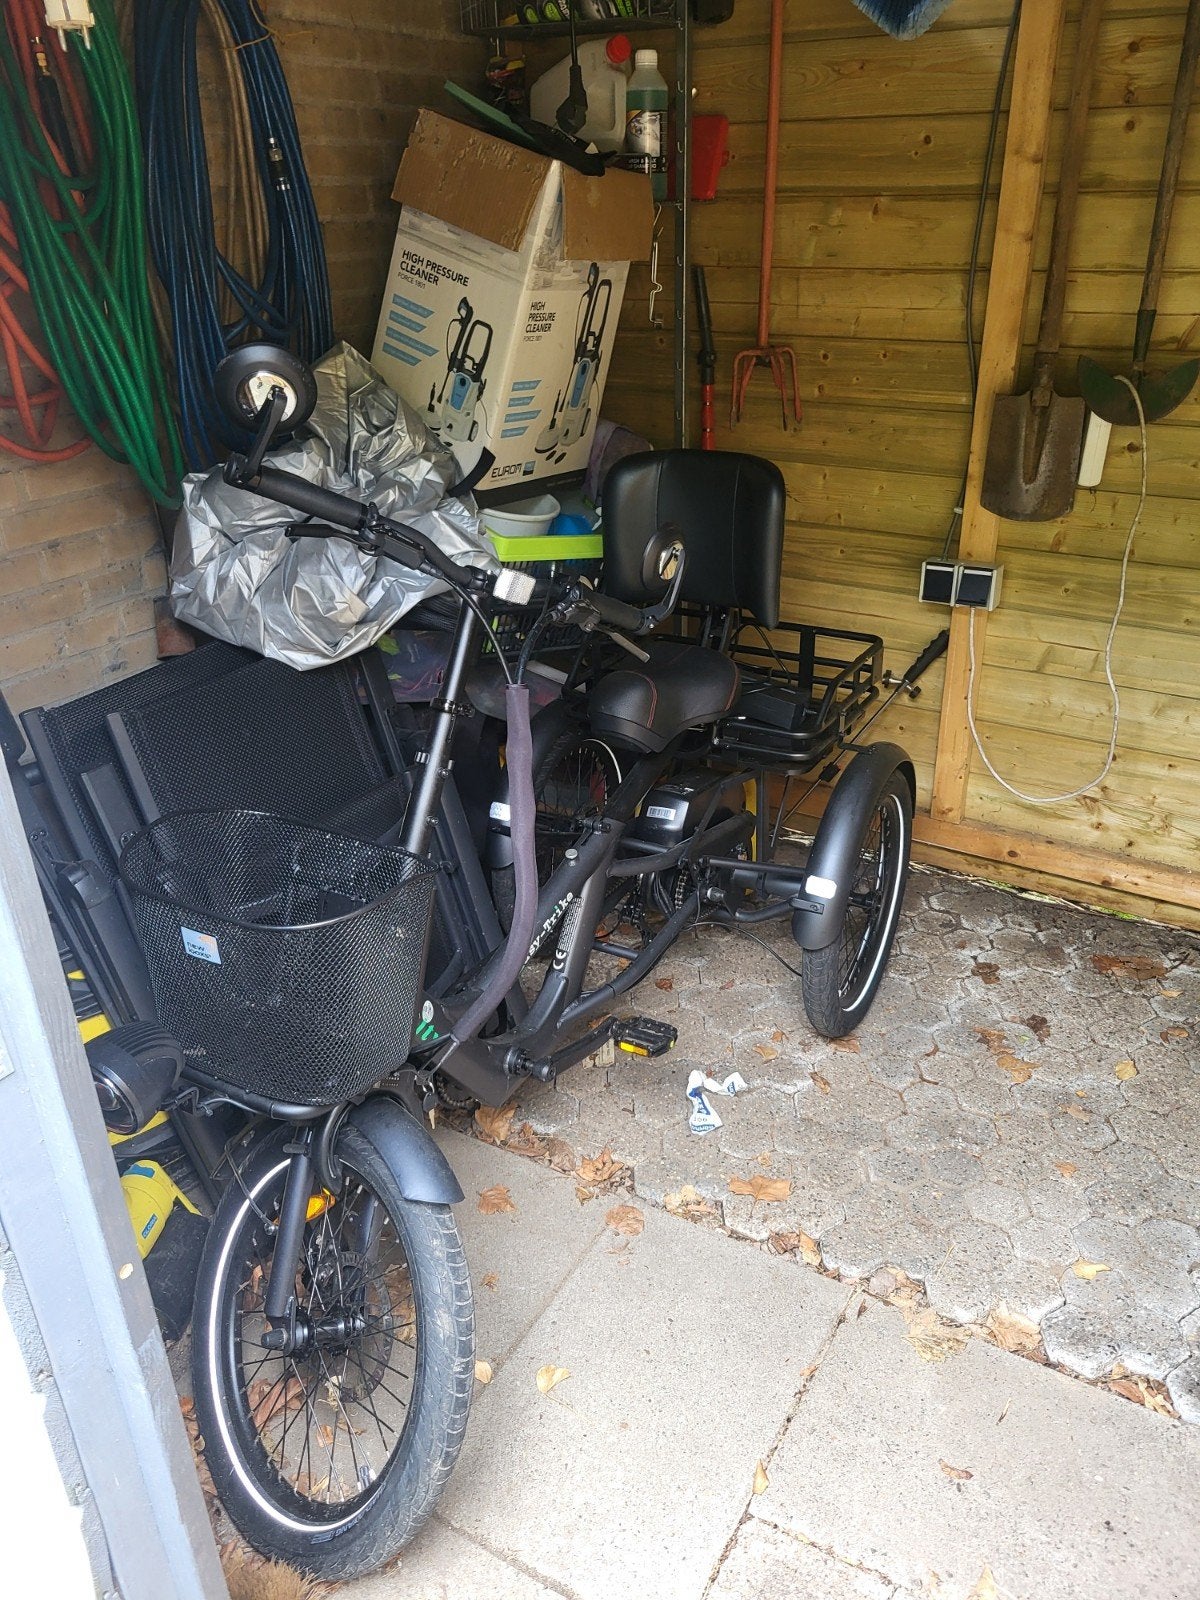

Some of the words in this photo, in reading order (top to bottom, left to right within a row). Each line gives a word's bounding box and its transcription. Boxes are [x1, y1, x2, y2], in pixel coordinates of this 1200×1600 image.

[400, 260, 440, 286] CLEANER
[402, 249, 424, 266] HIGH
[425, 259, 470, 287] PRESSURE
[397, 271, 415, 284] FORCE
[530, 301, 546, 311] HIGH
[528, 312, 556, 322] PRESSURE
[525, 323, 552, 333] CLEANER
[491, 463, 522, 478] EUROM
